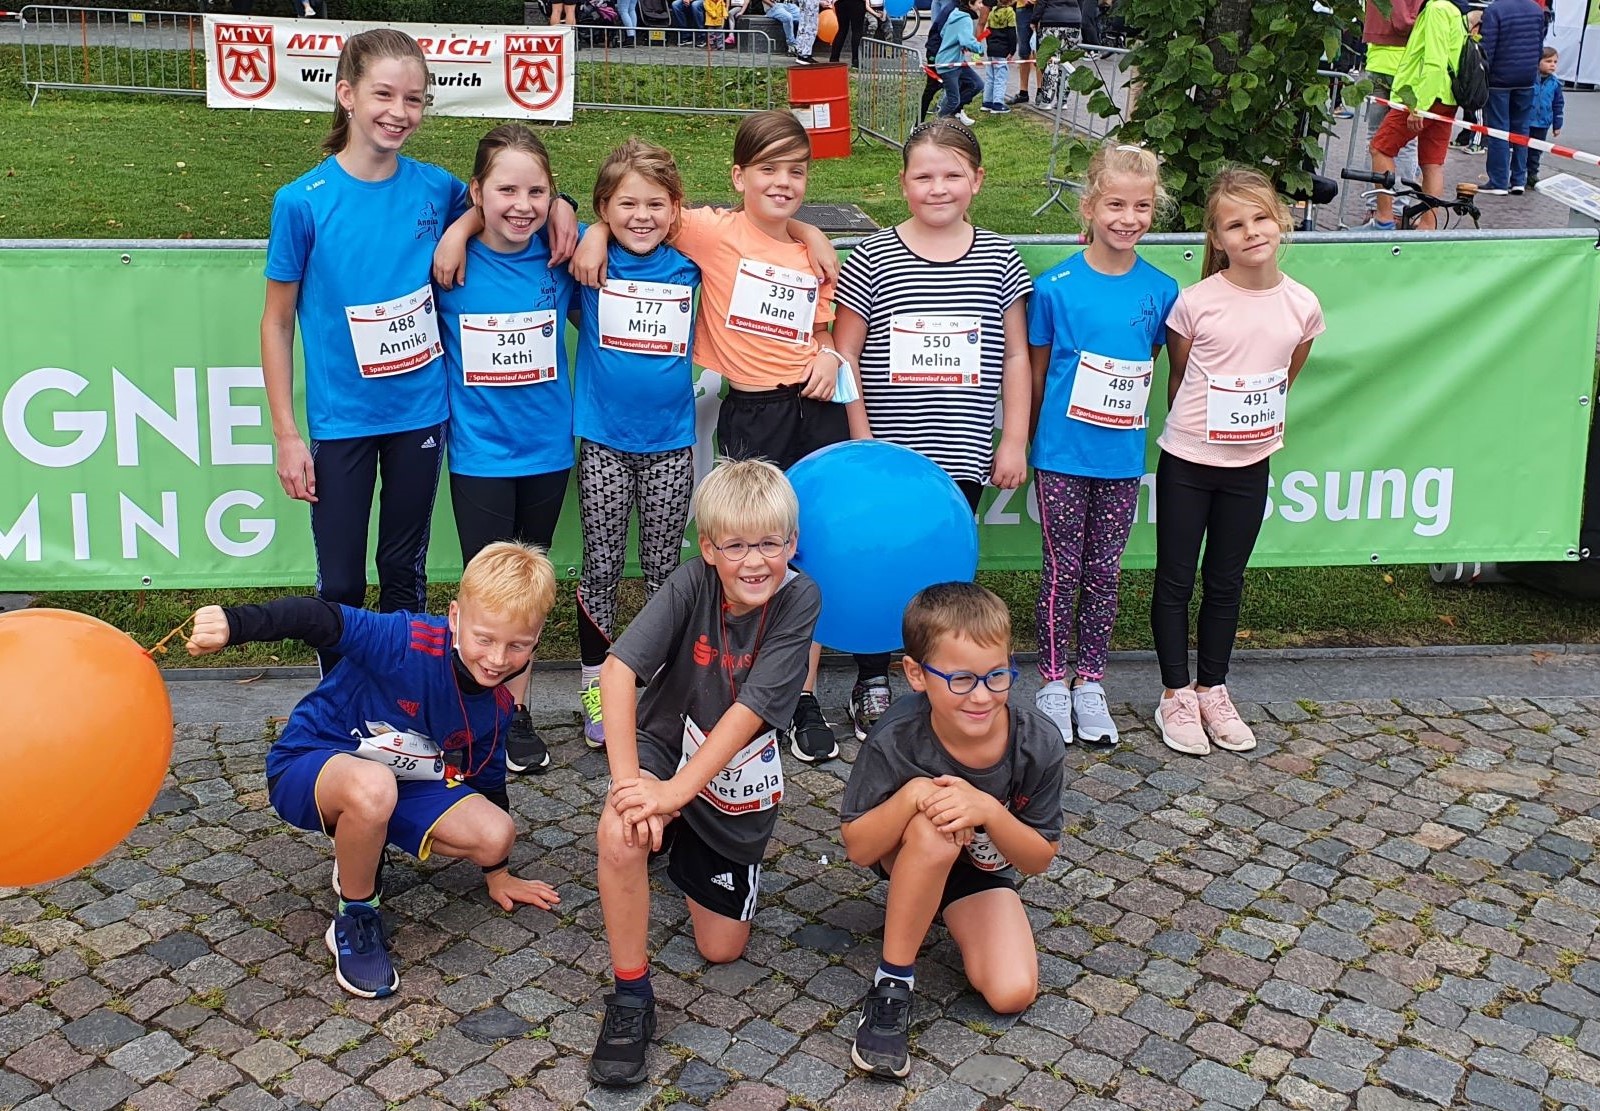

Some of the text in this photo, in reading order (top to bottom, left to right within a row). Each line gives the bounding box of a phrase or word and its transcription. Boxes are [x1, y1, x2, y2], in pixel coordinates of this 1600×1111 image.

[218, 27, 271, 42] MTV
[417, 38, 491, 56] RICH
[508, 38, 561, 52] MTV
[301, 69, 333, 83] Wir
[769, 284, 795, 301] 339
[635, 300, 663, 315] 177
[760, 301, 795, 321] Nane
[388, 315, 416, 333] 488
[628, 319, 666, 337] Mirja
[380, 332, 427, 355] Annika
[497, 332, 526, 347] 340
[608, 338, 650, 349] Sparkassenlauf
[923, 335, 951, 348] 550
[492, 349, 533, 365] Kathi
[911, 353, 961, 366] Melina
[473, 373, 517, 382] Sparkassenlauf
[1108, 378, 1134, 392] 489
[1103, 394, 1132, 410] Insa
[1243, 392, 1268, 406] 491
[1230, 409, 1275, 427] Sophie
[388, 755, 419, 771] 336
[719, 768, 743, 783] 37
[743, 774, 779, 797] Bela
